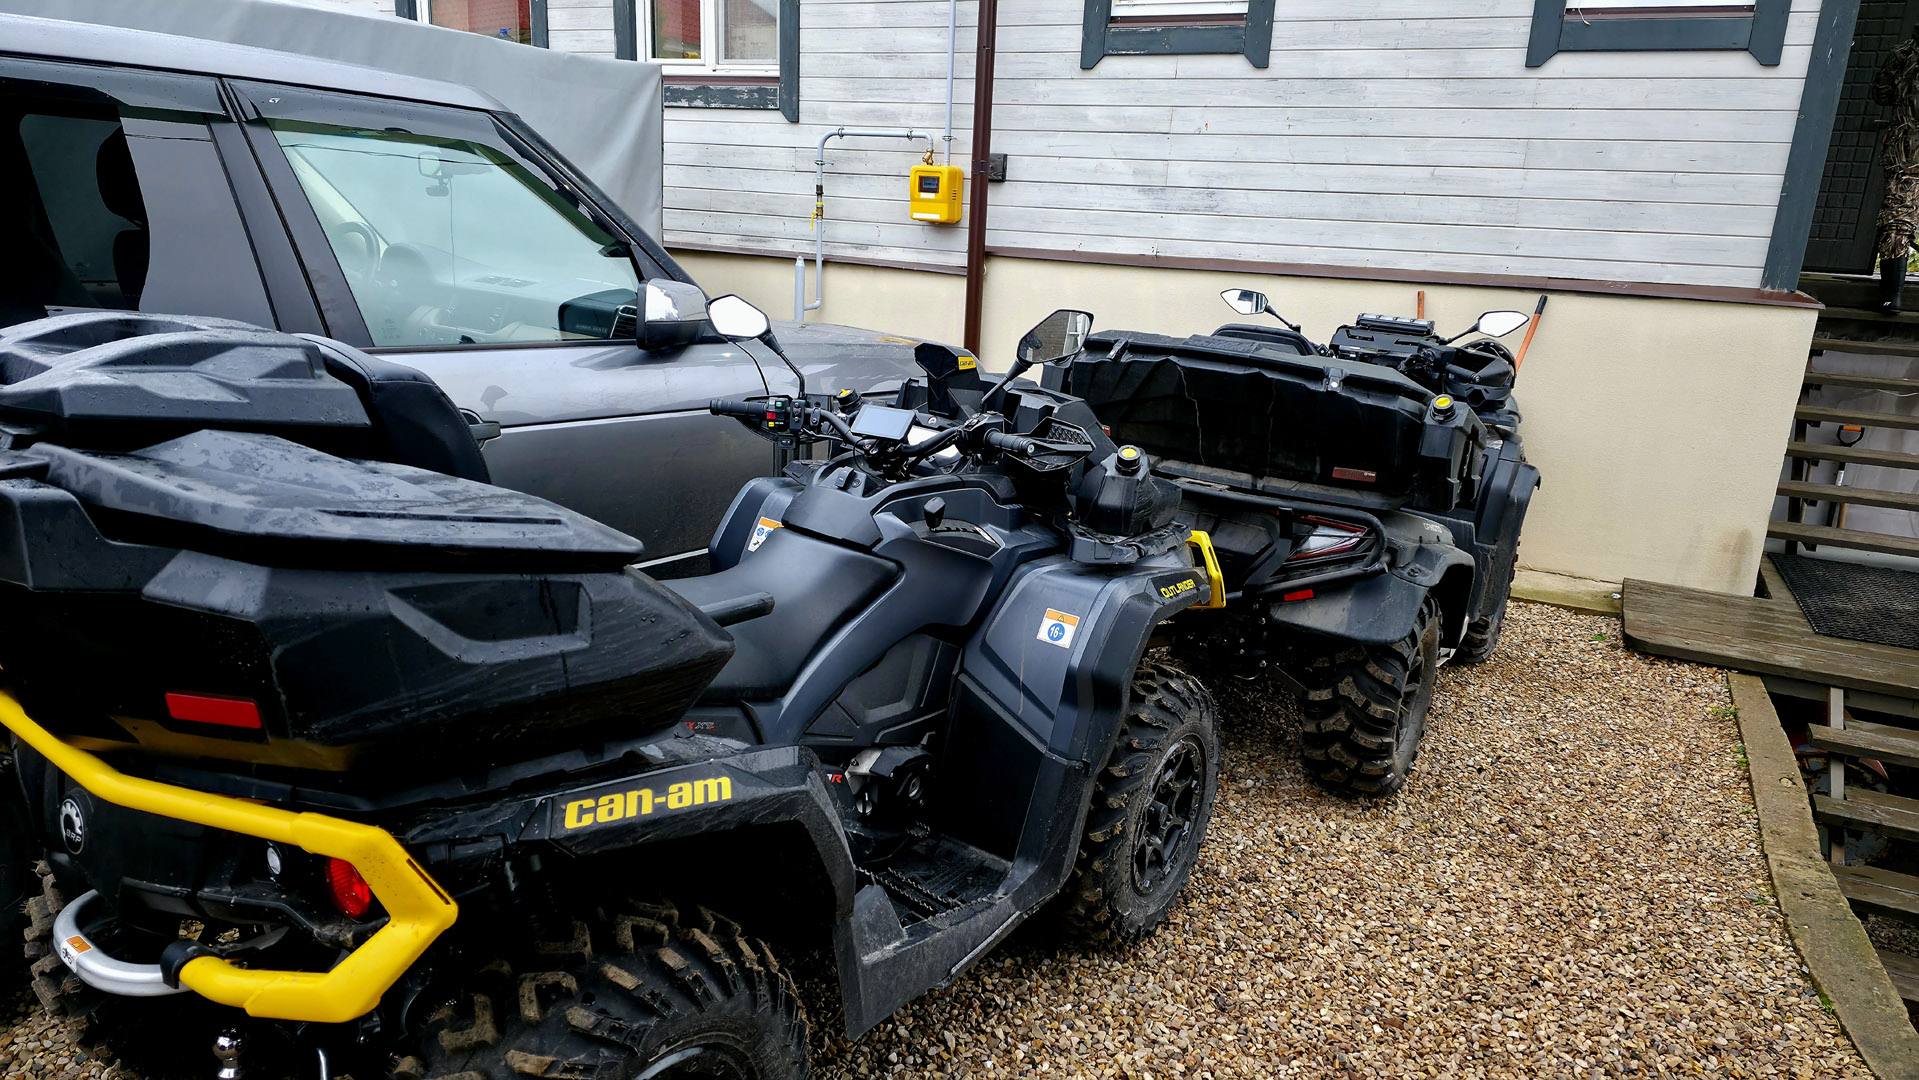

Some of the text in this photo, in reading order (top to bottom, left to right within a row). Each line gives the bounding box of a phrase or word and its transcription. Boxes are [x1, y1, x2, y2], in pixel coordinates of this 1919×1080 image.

[1160, 578, 1196, 599] OUTLANDER
[1050, 625, 1063, 638] 16+
[564, 776, 732, 829] can-am
[65, 828, 82, 842] BRP
